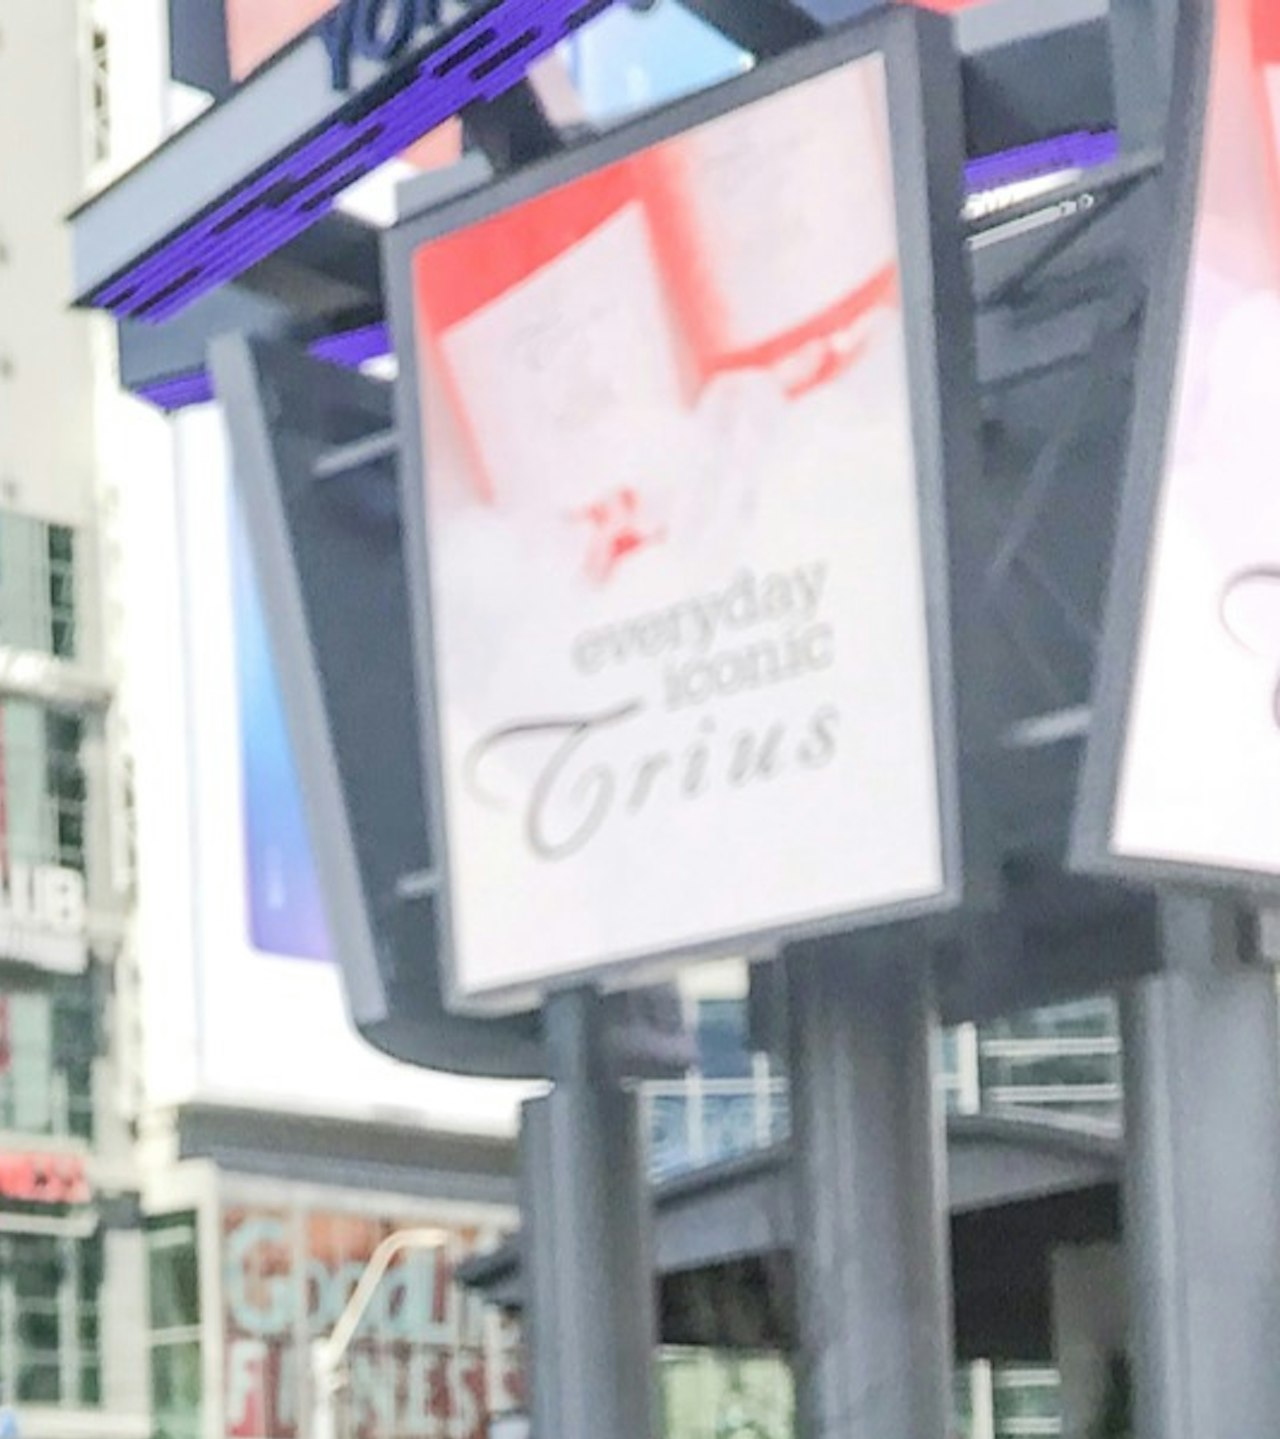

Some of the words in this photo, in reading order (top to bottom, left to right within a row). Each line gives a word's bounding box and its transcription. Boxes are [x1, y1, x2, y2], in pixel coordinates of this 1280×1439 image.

[320, 0, 440, 91] YO
[570, 560, 828, 676] everyday
[661, 620, 836, 712] iconic
[462, 696, 842, 864] Trius
